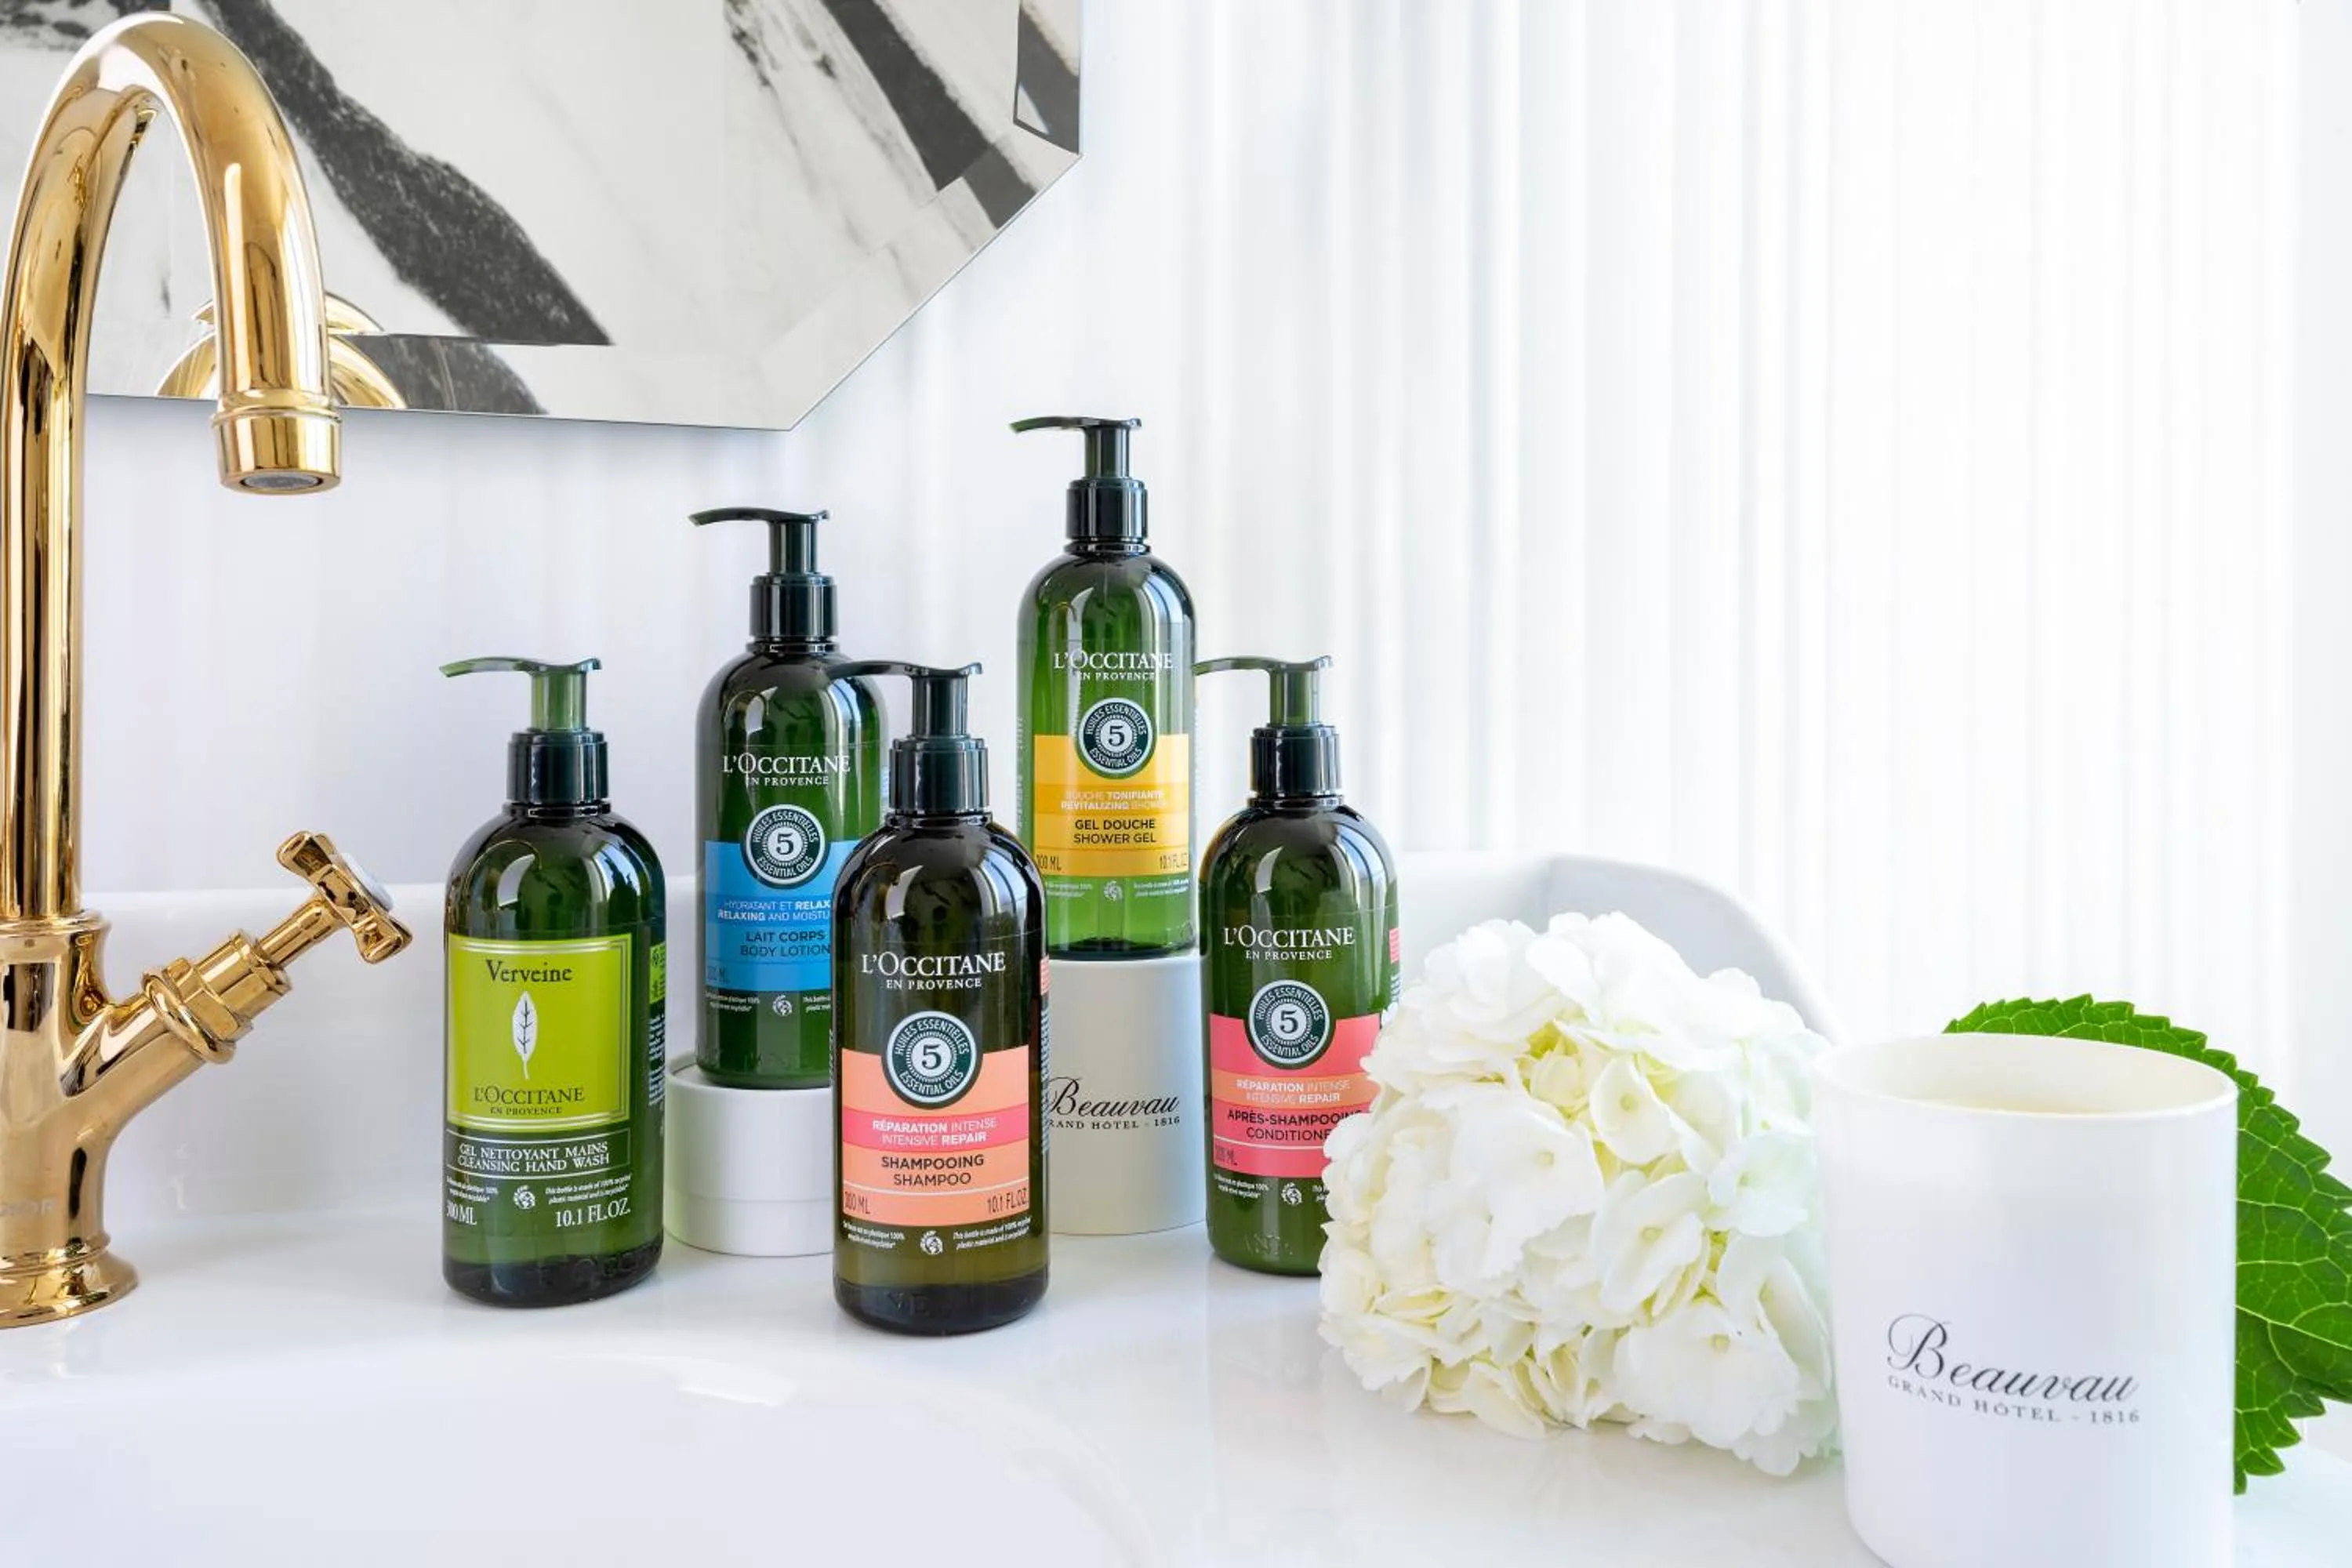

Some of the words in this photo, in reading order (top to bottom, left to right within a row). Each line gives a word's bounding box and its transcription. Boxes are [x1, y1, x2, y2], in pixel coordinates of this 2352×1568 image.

[1054, 649, 1174, 670] L'OCCITANE
[1096, 672, 1156, 681] PROVENCE
[1108, 725, 1125, 746] 5
[723, 753, 851, 774] L'OCCITANE
[764, 775, 829, 786] PROVENCE
[1075, 819, 1099, 830] GEL
[1103, 818, 1156, 830] DOUCHE
[776, 833, 794, 855] 5
[1074, 833, 1130, 844] SHOWER
[1134, 833, 1156, 844] GEL
[718, 909, 765, 921] RELAXING
[768, 912, 789, 921] AND
[780, 902, 792, 910] ET
[746, 931, 775, 942] LAIT
[779, 930, 826, 942] CORPS
[1224, 924, 1356, 949] L'OCCITANE
[740, 946, 776, 957] BODY
[781, 944, 831, 957] LOTION
[1246, 951, 1260, 960] EN
[1265, 949, 1333, 961] PROVENCE
[486, 959, 573, 982] Verveine
[862, 951, 1006, 977] L'OCCITANE
[887, 980, 902, 989] EN
[908, 978, 982, 990] PROVENCE
[1279, 1010, 1299, 1034] 5
[894, 1024, 918, 1056] HUILES
[916, 1018, 970, 1054] ESSENTIELLES
[1260, 1034, 1301, 1057] ESSENTIAL
[922, 1044, 942, 1070] 5
[898, 1070, 946, 1095] ESSENTIAL
[944, 1069, 964, 1088] OILS
[1236, 1079, 1304, 1092] RÉPARATION
[474, 1086, 586, 1105] L'OCCITANE
[1050, 1076, 1181, 1117] Beauvau
[1299, 1093, 1341, 1103] REPAIR
[506, 1106, 562, 1116] PROVENCE
[872, 1119, 948, 1133] RÉPARATION
[951, 1116, 998, 1131] INTENSE
[1050, 1120, 1084, 1130] RAND
[1091, 1120, 1139, 1131] HÔTEL
[1154, 1116, 1180, 1127] 1816
[881, 1134, 938, 1146] INTENSIVE
[941, 1131, 988, 1145] REPAIR
[1246, 1127, 1332, 1141] CONDITIONE
[459, 1143, 477, 1157] GEL
[481, 1147, 560, 1161] NETTOYANT
[565, 1142, 608, 1157] MAINS
[458, 1155, 520, 1173] CLEANSING
[526, 1159, 567, 1172] HAND
[575, 1153, 609, 1168] WASH
[881, 1154, 985, 1171] SHAMPOOING
[894, 1172, 971, 1186] SHAMPOO
[557, 1208, 583, 1228] 10.1
[1886, 1313, 2140, 1403] Beauvau
[1888, 1375, 1962, 1408] GRAND
[1975, 1399, 2061, 1423] HÔTEL
[2090, 1410, 2140, 1425] 1816
